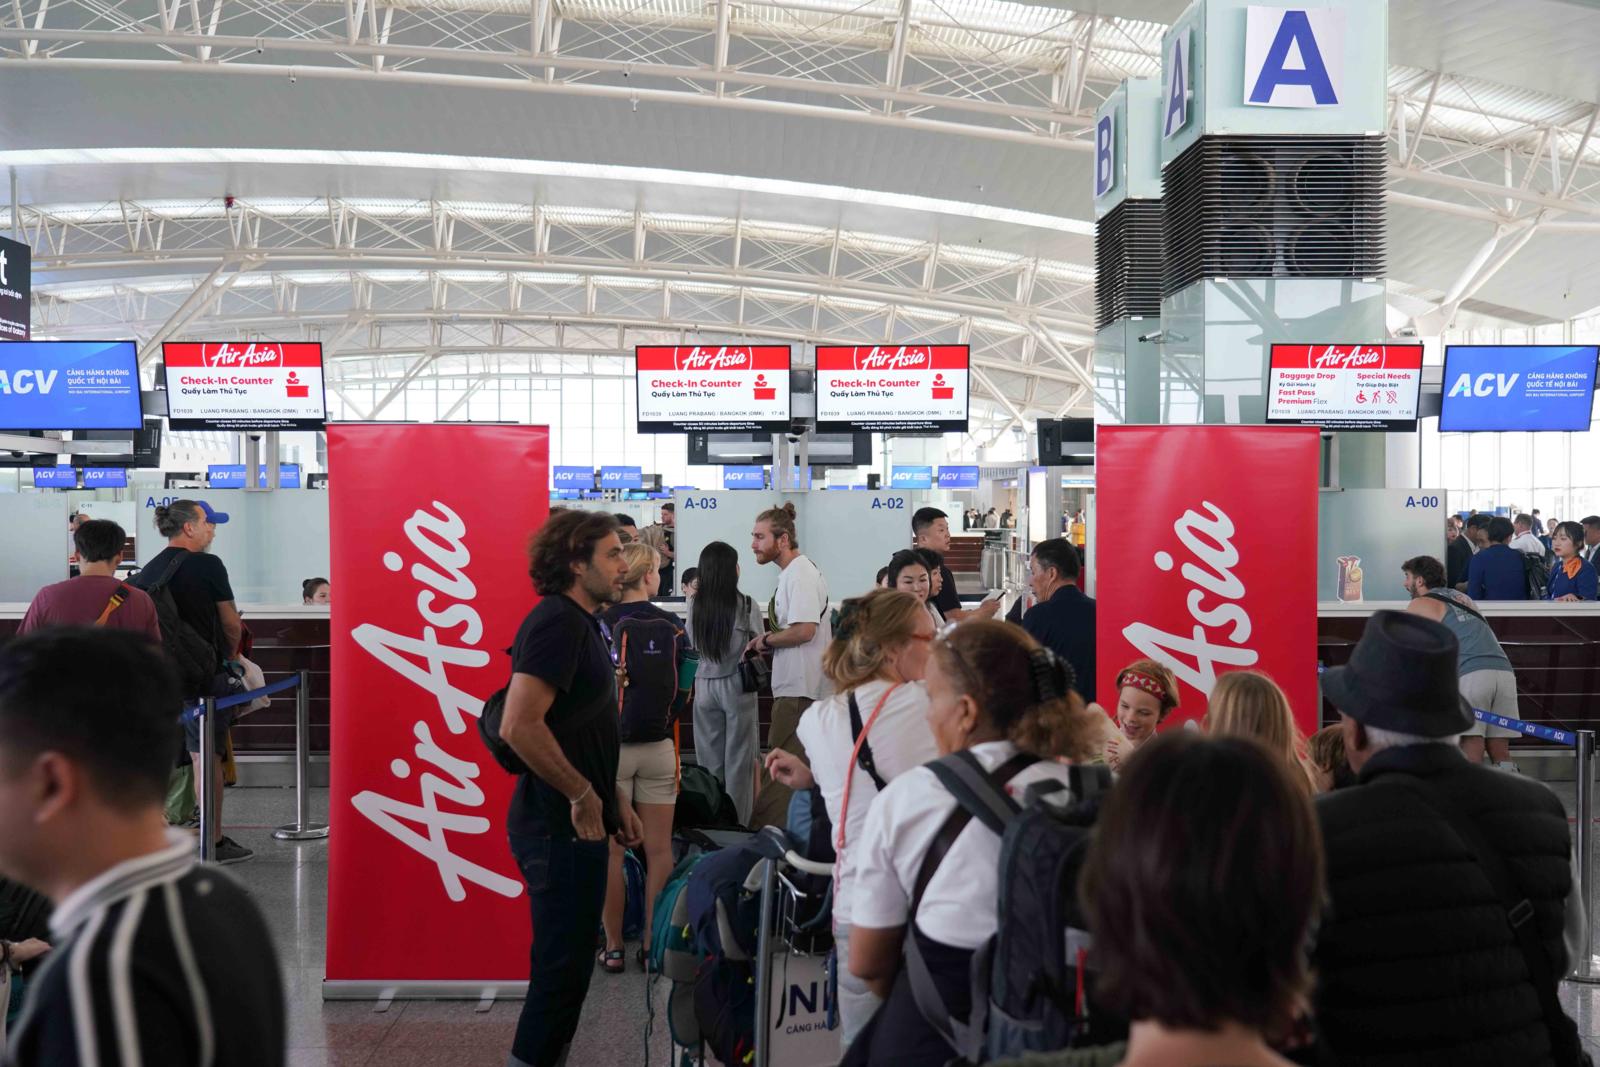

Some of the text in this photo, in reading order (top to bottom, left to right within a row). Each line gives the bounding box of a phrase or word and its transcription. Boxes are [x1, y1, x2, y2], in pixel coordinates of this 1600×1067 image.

[1248, 10, 1339, 105] A
[1164, 38, 1185, 138] A
[1097, 115, 1112, 197] B
[210, 344, 277, 368] AirAsia
[682, 347, 746, 370] AirAsia
[861, 346, 925, 370] AirAsia
[1315, 346, 1380, 369] AirAsia
[180, 377, 274, 385] Check-In Counter
[652, 380, 742, 388] Check-In Counter
[830, 379, 920, 388] Check-In Counter
[1448, 373, 1520, 397] ACV
[202, 388, 218, 396] Làm
[235, 388, 248, 396] Tục
[672, 390, 687, 398] Làm
[704, 390, 716, 398] Tục
[850, 390, 865, 398] Làm
[882, 390, 894, 398] Tục
[36, 471, 54, 479] ACV
[85, 471, 104, 479] ACV
[555, 472, 574, 480] ACV
[602, 472, 622, 480] ACV
[725, 472, 744, 480] ACV
[684, 498, 717, 509] A-03
[872, 498, 904, 509] A-02
[1406, 496, 1438, 508] A-00
[1122, 500, 1259, 702] Asia
[351, 500, 524, 903] AirAsia
[1554, 731, 1565, 740] ACV
